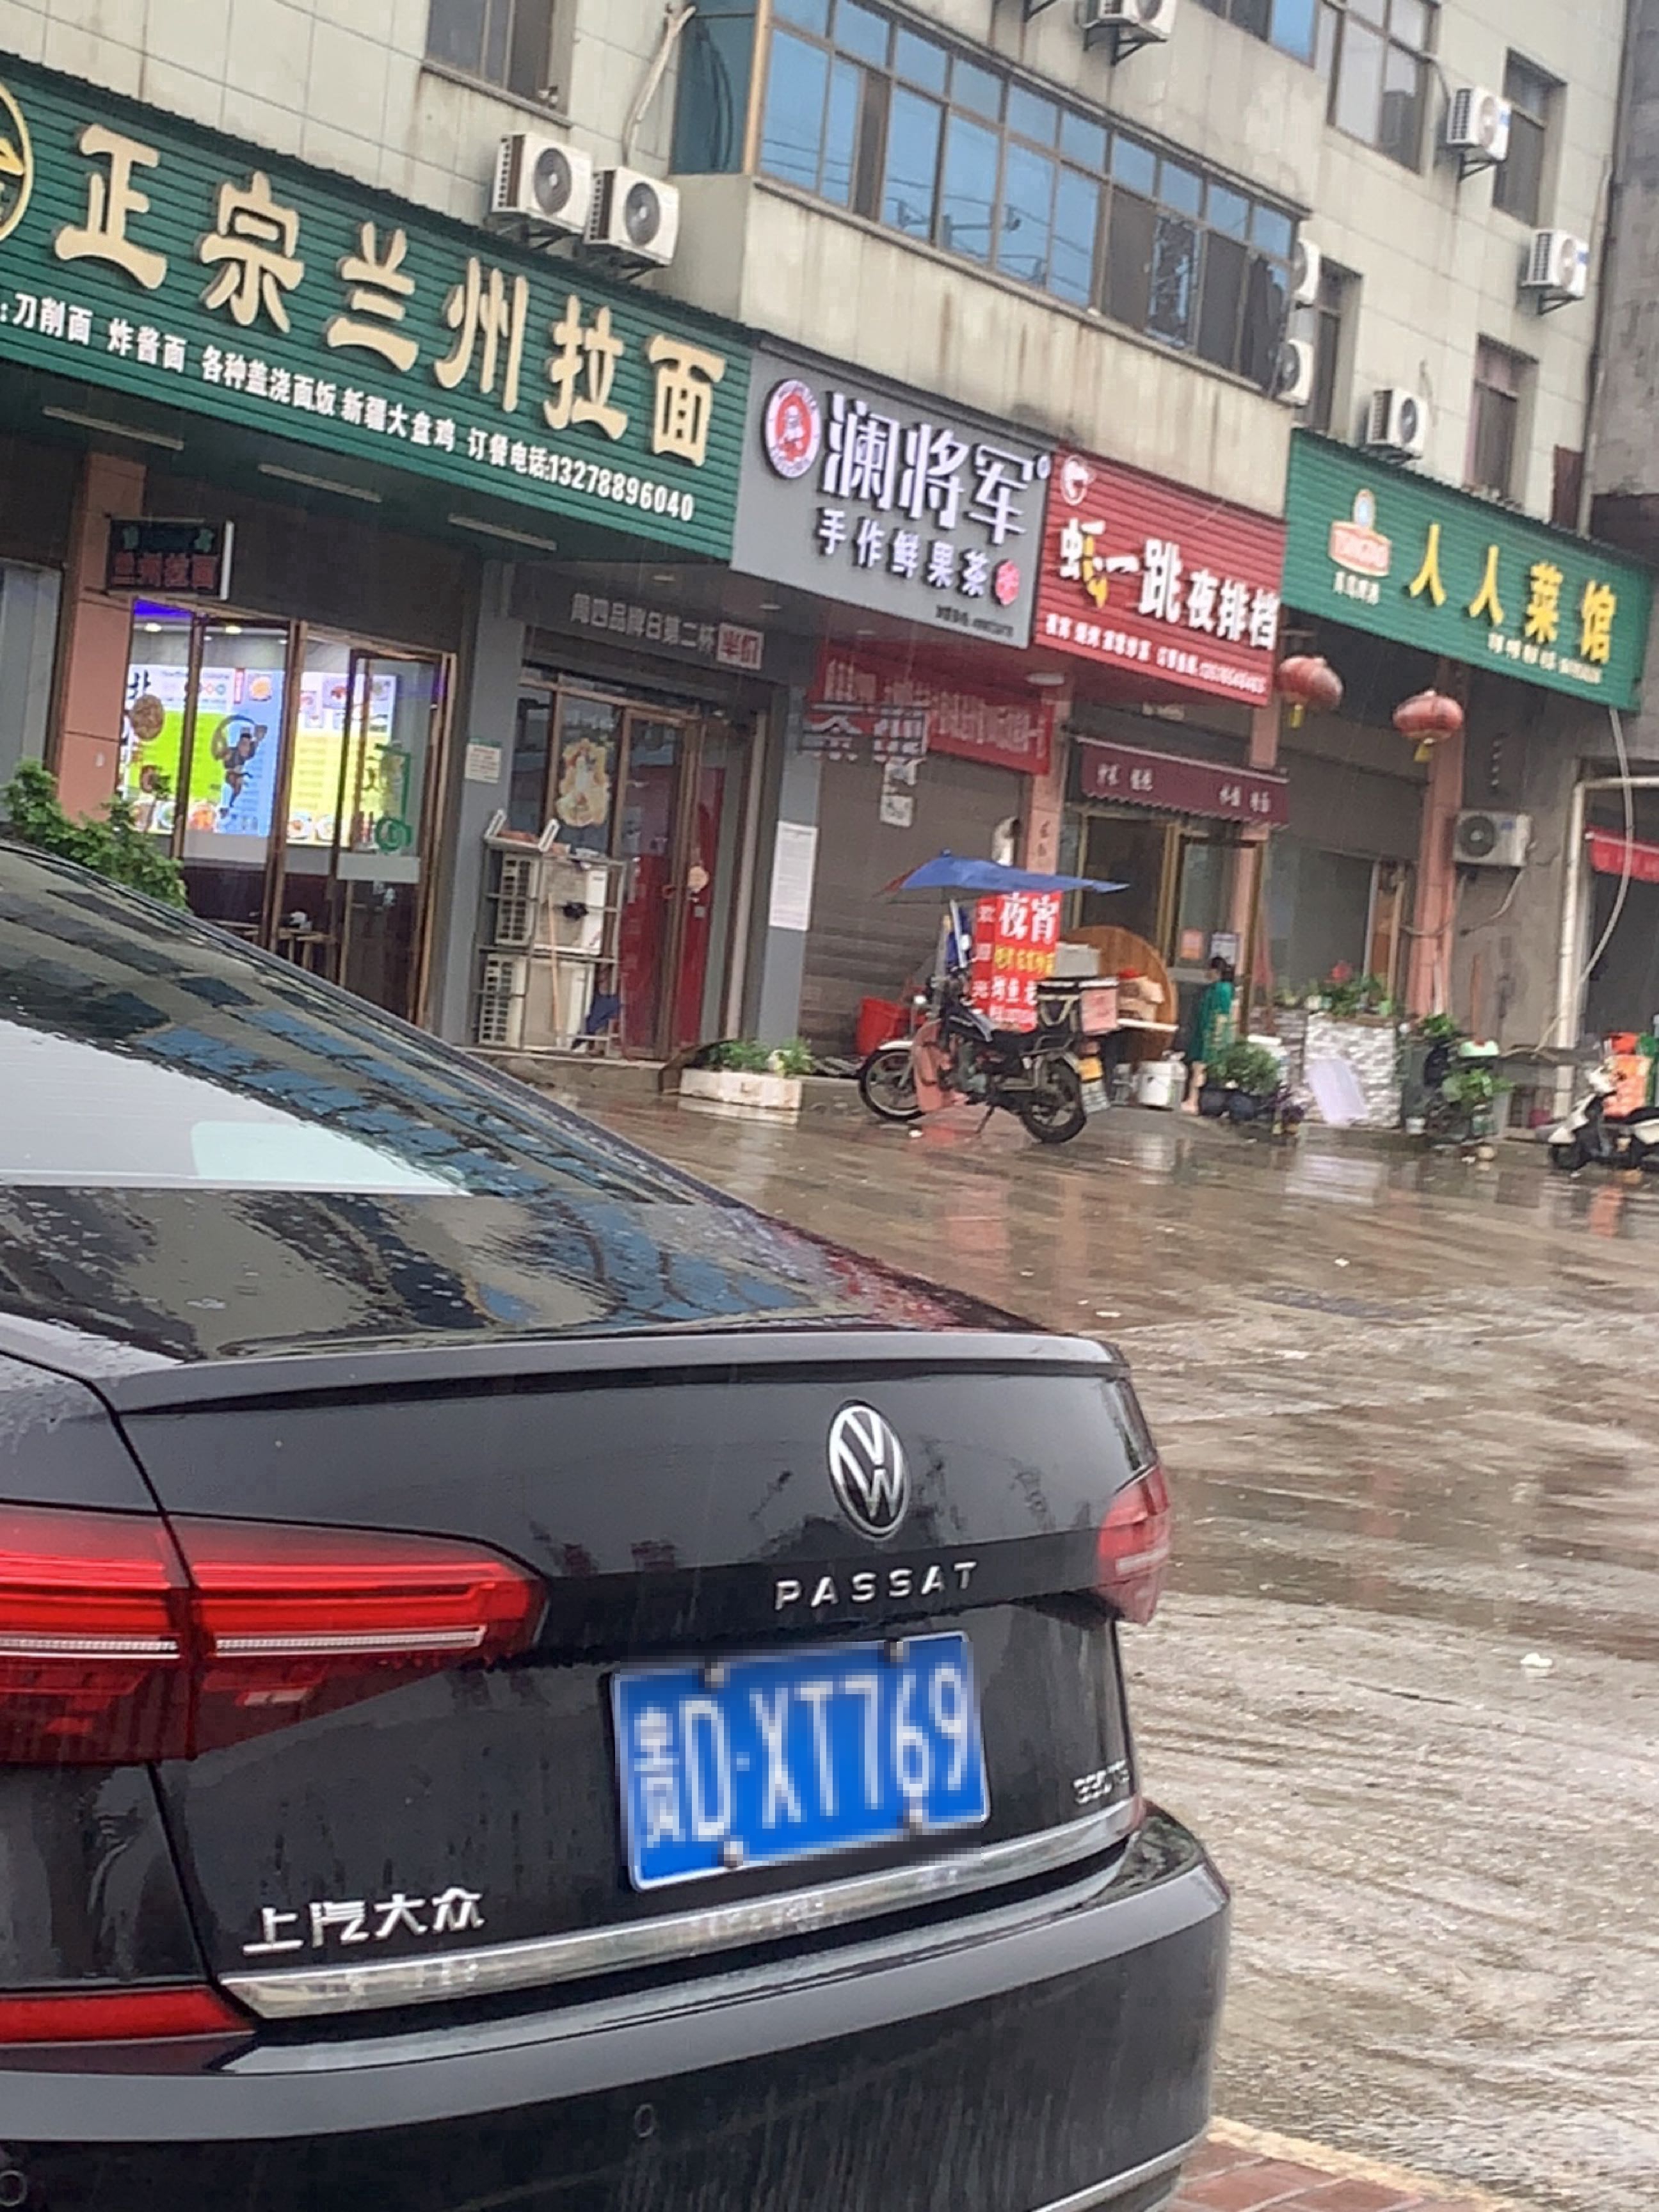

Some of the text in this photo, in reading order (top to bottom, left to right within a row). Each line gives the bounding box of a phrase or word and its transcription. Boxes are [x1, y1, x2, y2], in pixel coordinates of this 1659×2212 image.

[56, 124, 726, 467] 正宗兰州拉面
[108, 317, 187, 373] 炸酱面
[341, 387, 456, 453] 新疆大盘鸡
[823, 392, 1033, 545] 澜将军
[819, 508, 990, 597] 手作鲜果茶
[1409, 524, 1617, 664] 人人菜馆
[999, 892, 1060, 944] 夜宵
[774, 1561, 977, 1610] PASSAT
[243, 1887, 485, 1955] 上汽大众
